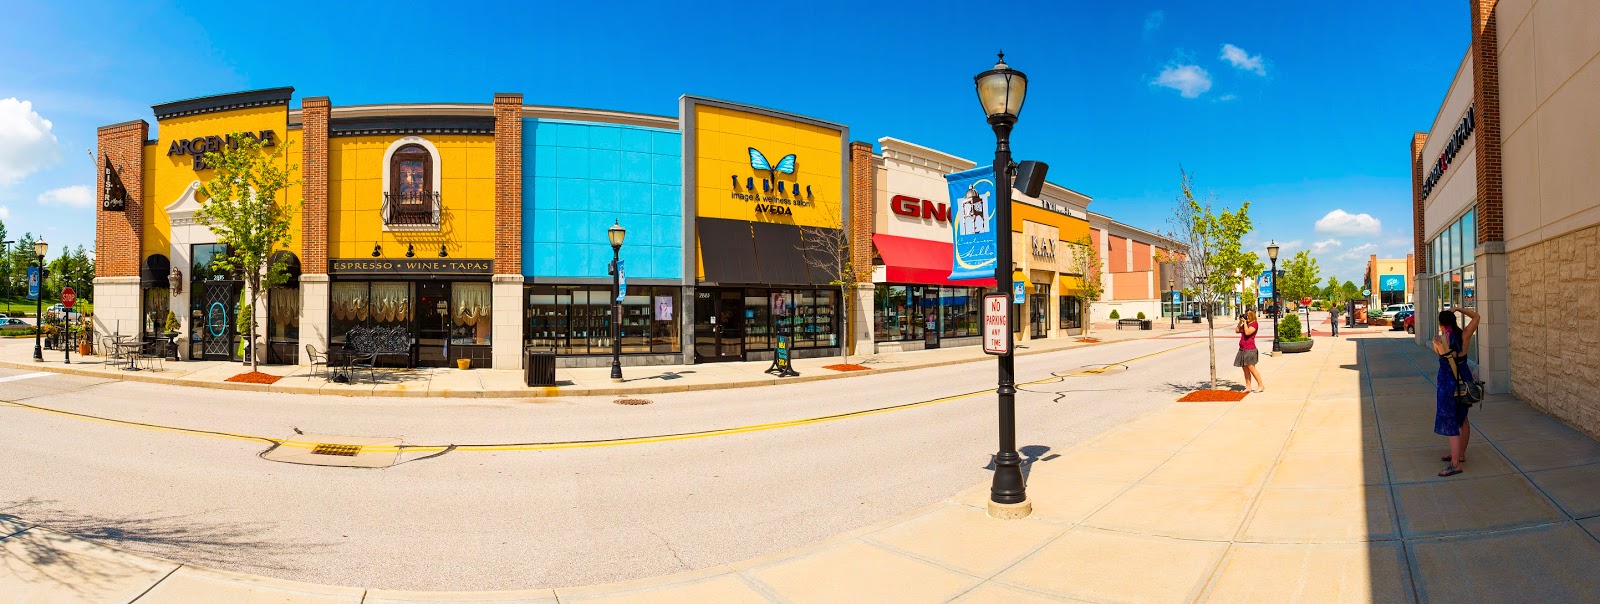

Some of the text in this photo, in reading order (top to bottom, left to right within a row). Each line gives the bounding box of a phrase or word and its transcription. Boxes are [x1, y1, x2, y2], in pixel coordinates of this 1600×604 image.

[731, 191, 811, 208] image & wellness salon
[754, 203, 793, 216] AVEDA
[890, 195, 952, 225] GN
[1032, 235, 1056, 251] KAY
[333, 262, 489, 270] ESPRESSO WINE TAPAS
[991, 301, 1001, 311] NO
[986, 315, 1006, 325] PARKING
[991, 338, 1001, 346] TIME
